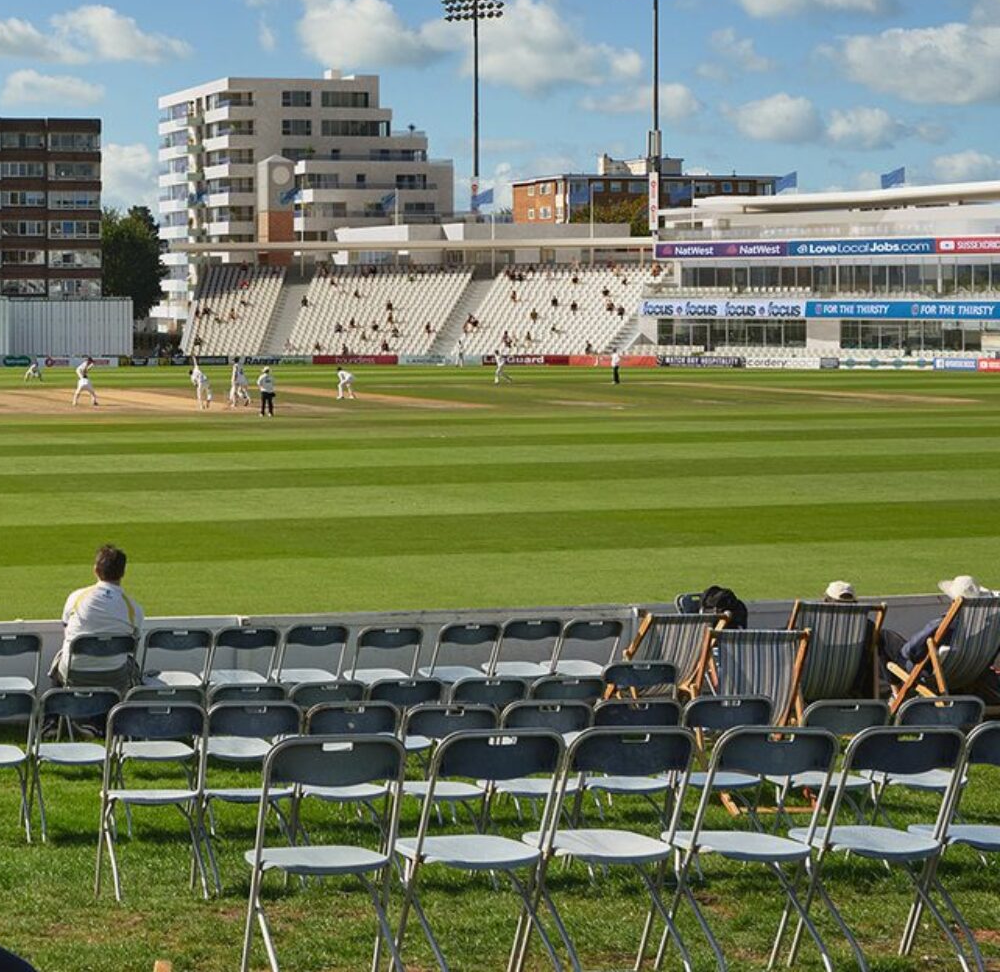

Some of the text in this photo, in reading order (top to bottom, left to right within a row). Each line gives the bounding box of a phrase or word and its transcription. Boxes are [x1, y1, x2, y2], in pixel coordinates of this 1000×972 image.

[674, 246, 714, 256] NatWest
[739, 244, 781, 255] NatWest
[809, 240, 930, 253] LoveLocalJobs.com
[643, 301, 718, 317] focus focus
[725, 301, 801, 317] focus focus
[823, 304, 890, 315] FOR THE THIRSTY
[920, 304, 995, 315] FOR THE THIRSTY
[483, 355, 544, 364] LaGuard
